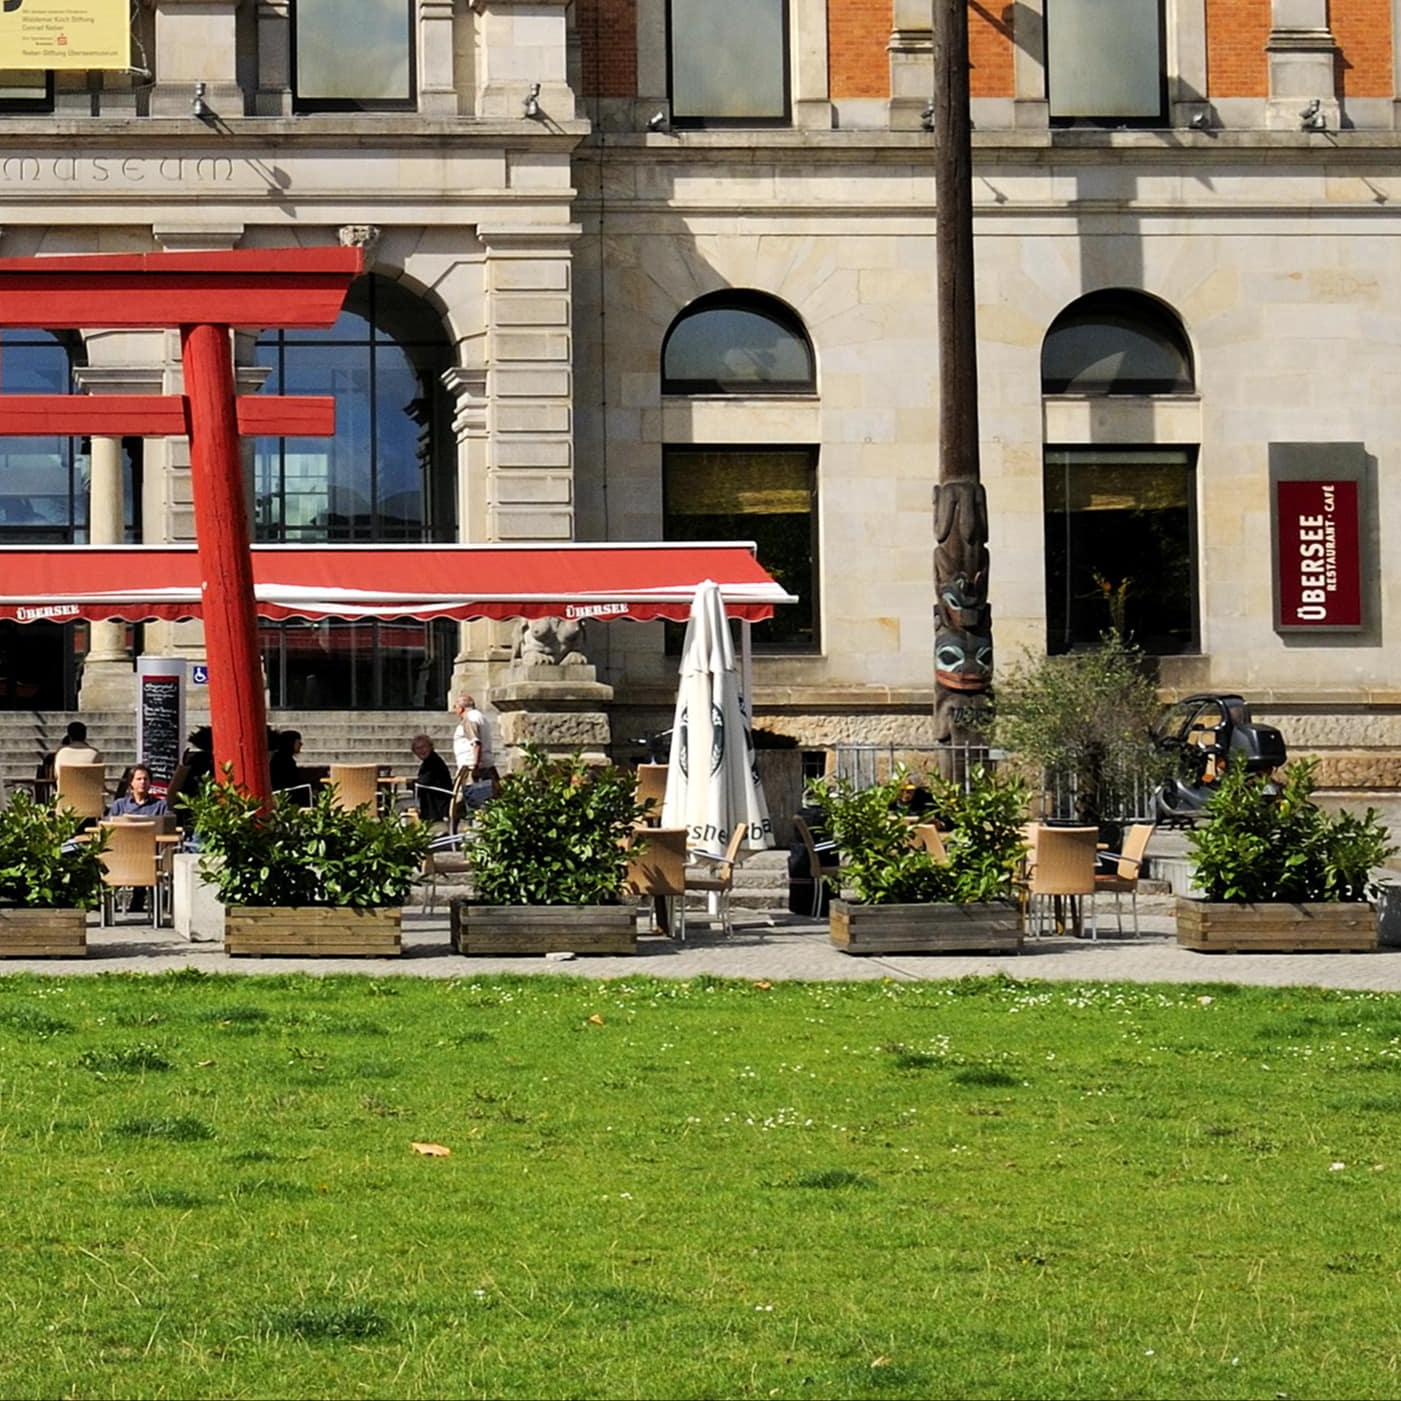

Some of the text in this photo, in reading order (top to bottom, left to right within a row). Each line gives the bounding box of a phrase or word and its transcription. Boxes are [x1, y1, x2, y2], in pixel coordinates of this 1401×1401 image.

[1297, 515, 1327, 620] ÜBERSEE
[1325, 520, 1336, 591] RESTAURANT
[16, 603, 80, 620] ÜBERSEE
[565, 602, 630, 618] ÜBERSEE
